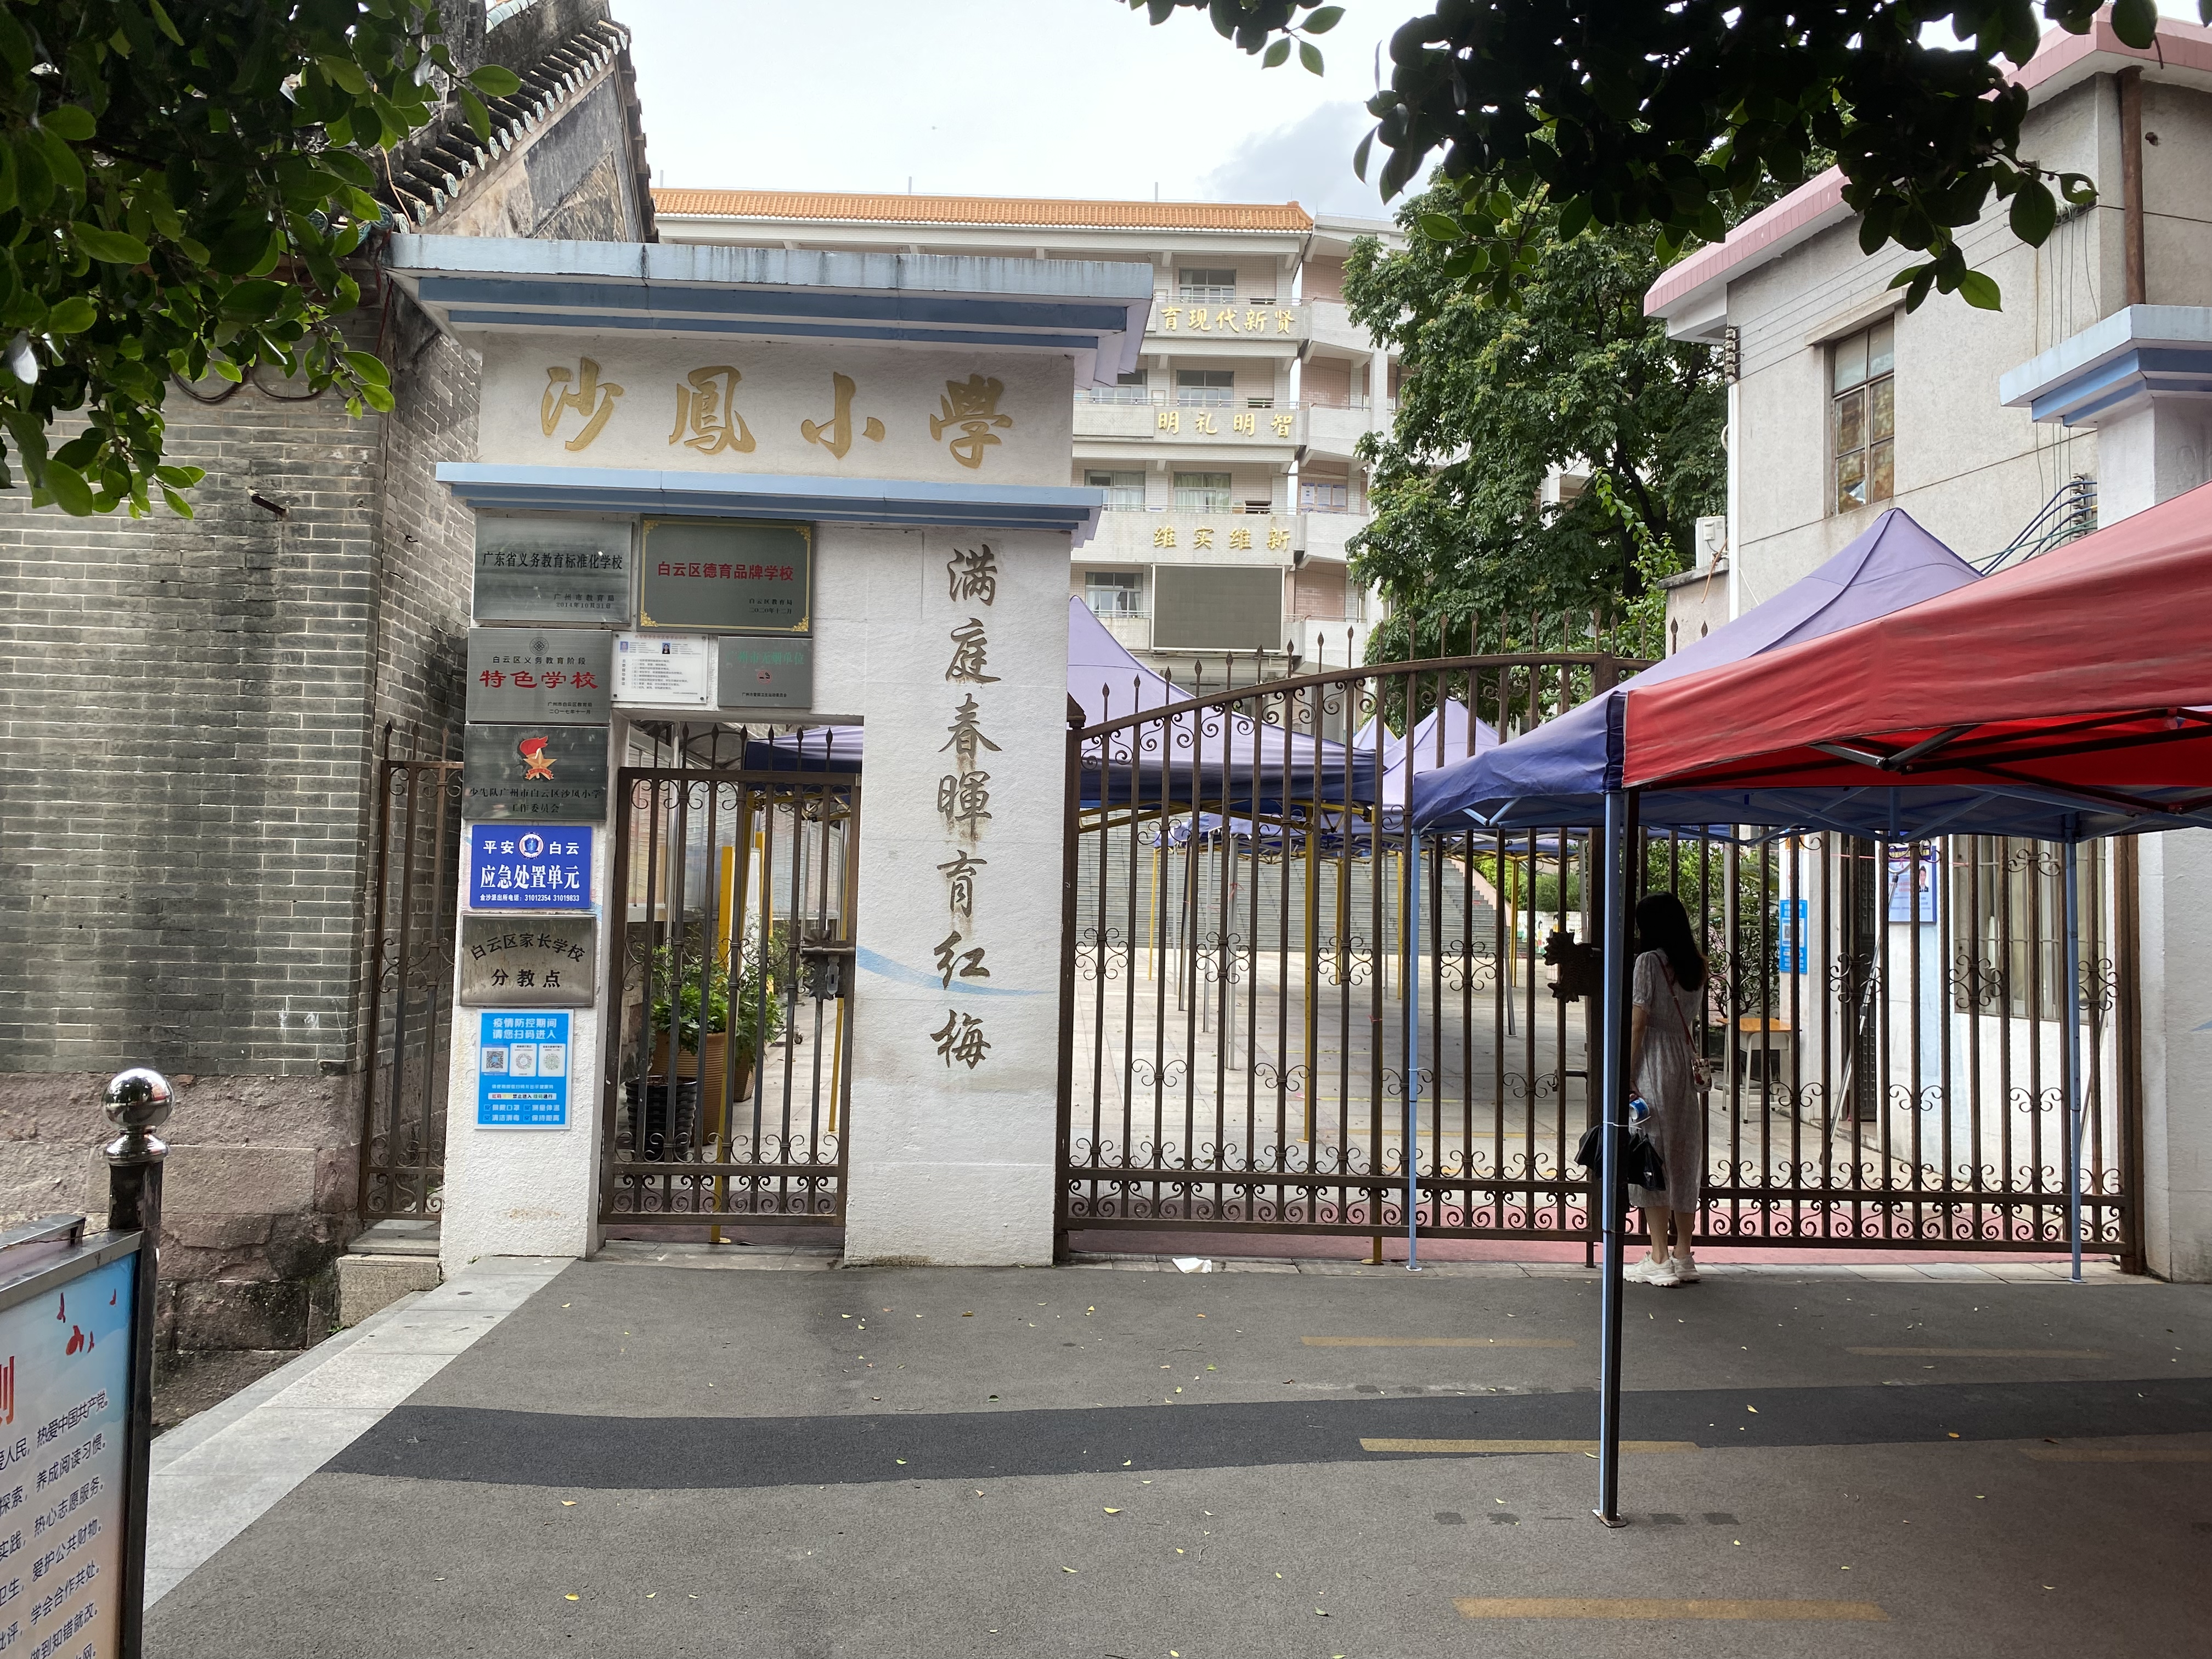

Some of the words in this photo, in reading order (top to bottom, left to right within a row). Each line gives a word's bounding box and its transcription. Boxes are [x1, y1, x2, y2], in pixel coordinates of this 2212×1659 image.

[1160, 306, 1296, 334] 育现代新贤
[541, 357, 1013, 469] 沙鳳小學
[1158, 411, 1294, 439] 明礼明智
[1153, 525, 1291, 552] 维实维新
[482, 551, 623, 570] 广东省义务教育标准化学校
[657, 561, 794, 581] 白云区德育品牌学校
[552, 594, 615, 602] 广州市教育局
[493, 656, 586, 665] 白云区义务教育阶段
[479, 669, 599, 689] 特色学校
[470, 787, 602, 799] 少先队广州市白云区沙凤小学
[512, 803, 560, 814] 工作委员会
[483, 840, 515, 854] 平安
[549, 841, 580, 855] 白云
[480, 864, 580, 890] 应急处置单元
[470, 932, 585, 962] 白云区家长学校
[491, 968, 561, 988] 分教点
[493, 1018, 557, 1028] 疫情防控期间
[493, 1029, 556, 1039] 请您扫码进入
